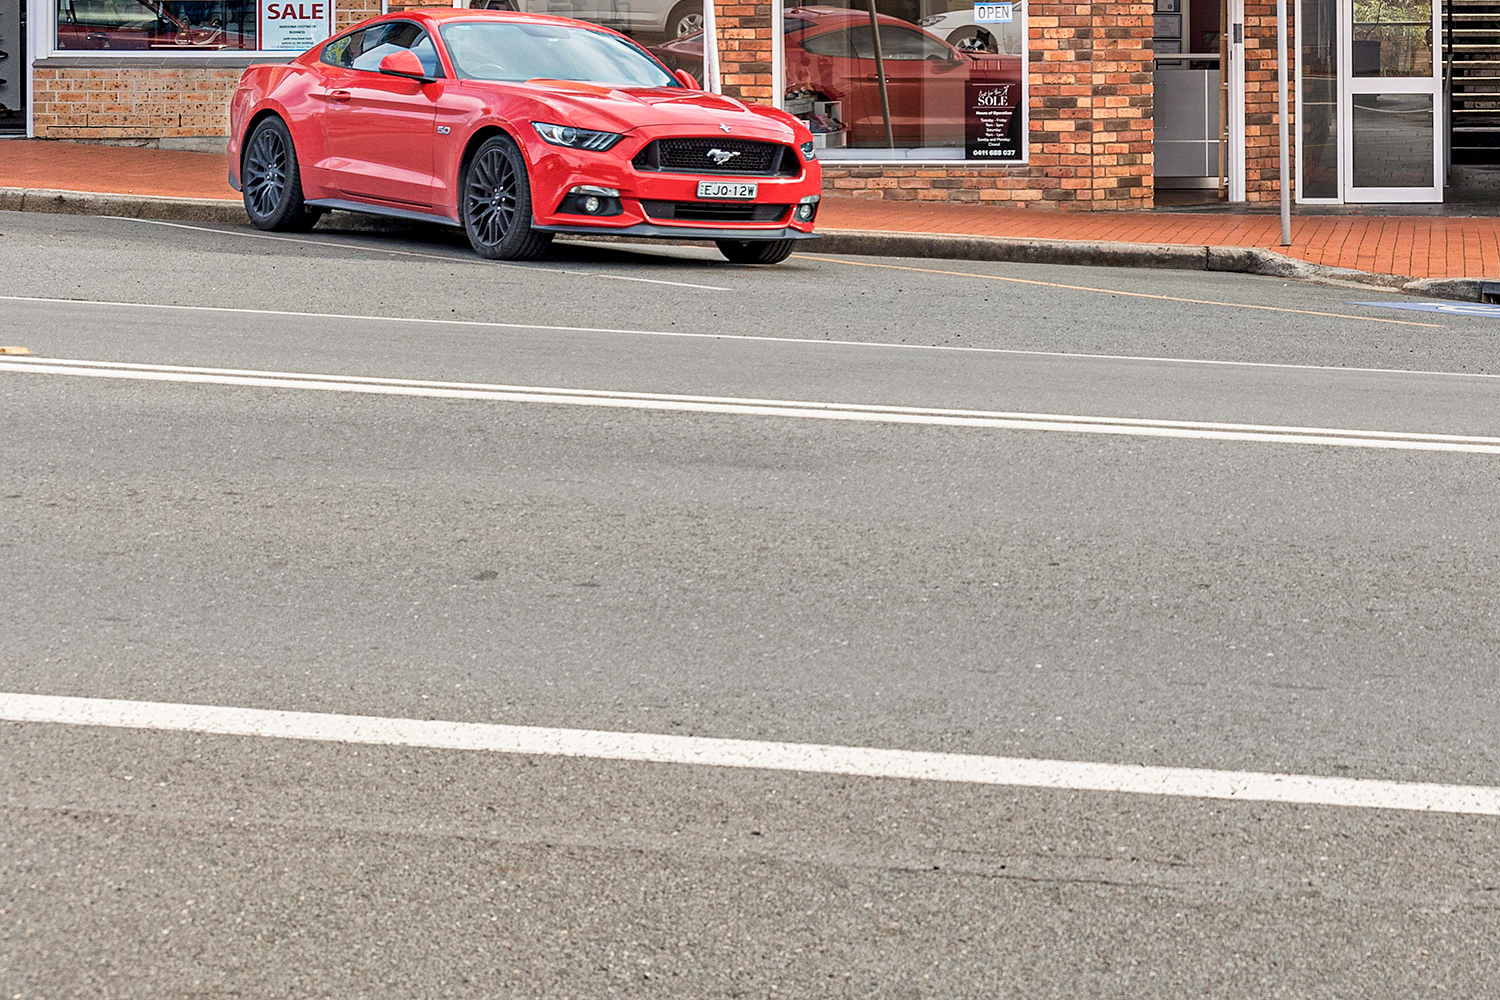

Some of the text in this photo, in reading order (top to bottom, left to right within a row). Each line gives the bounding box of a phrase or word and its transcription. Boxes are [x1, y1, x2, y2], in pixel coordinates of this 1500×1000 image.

[267, 3, 324, 20] SALE
[978, 5, 1010, 19] OPEN
[977, 96, 1008, 106] SOLE
